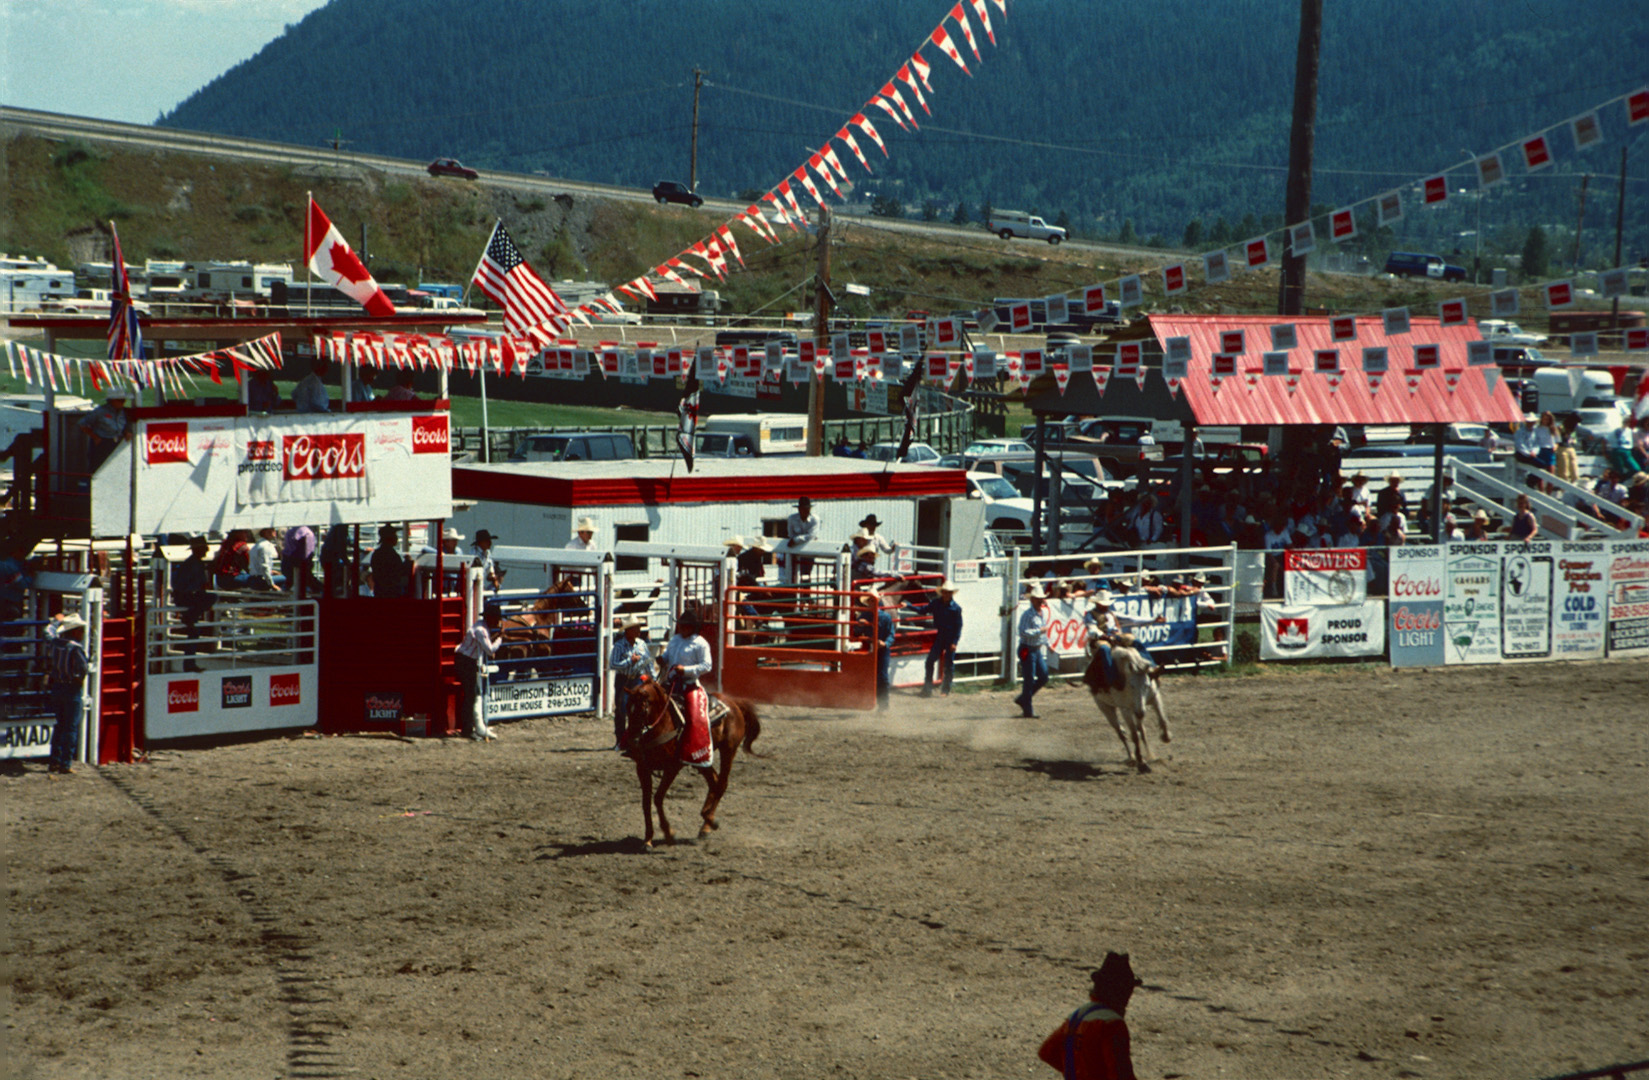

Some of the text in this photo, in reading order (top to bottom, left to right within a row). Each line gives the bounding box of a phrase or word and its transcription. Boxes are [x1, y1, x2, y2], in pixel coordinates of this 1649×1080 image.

[413, 426, 447, 445] Coors
[148, 434, 186, 453] Coors
[285, 436, 364, 476] Coors
[238, 461, 283, 476] prorodeo
[1397, 548, 1439, 558] SPONSOR
[1450, 544, 1498, 555] SPONSOR
[1504, 543, 1552, 554] SPONSOR
[1562, 543, 1604, 553] SPONSOR
[1289, 552, 1361, 569] GROWERS
[1393, 574, 1441, 596] Coors
[1564, 596, 1595, 611] COLD
[1328, 619, 1361, 630] PROUD
[1392, 607, 1440, 630] Coors
[1321, 633, 1367, 644] SPONSOR
[1399, 632, 1435, 646] LIGHT
[224, 682, 251, 695] Coors
[271, 684, 300, 698] Coors
[496, 684, 544, 701] Williamson
[547, 681, 590, 697] Blacktop
[169, 690, 198, 704] Coors
[226, 694, 248, 704] LIGHT
[366, 696, 401, 709] Coors
[500, 702, 518, 711] MILE
[520, 700, 542, 709] HOUSE
[547, 697, 581, 708] 296-3353
[370, 709, 397, 718] LIGHT
